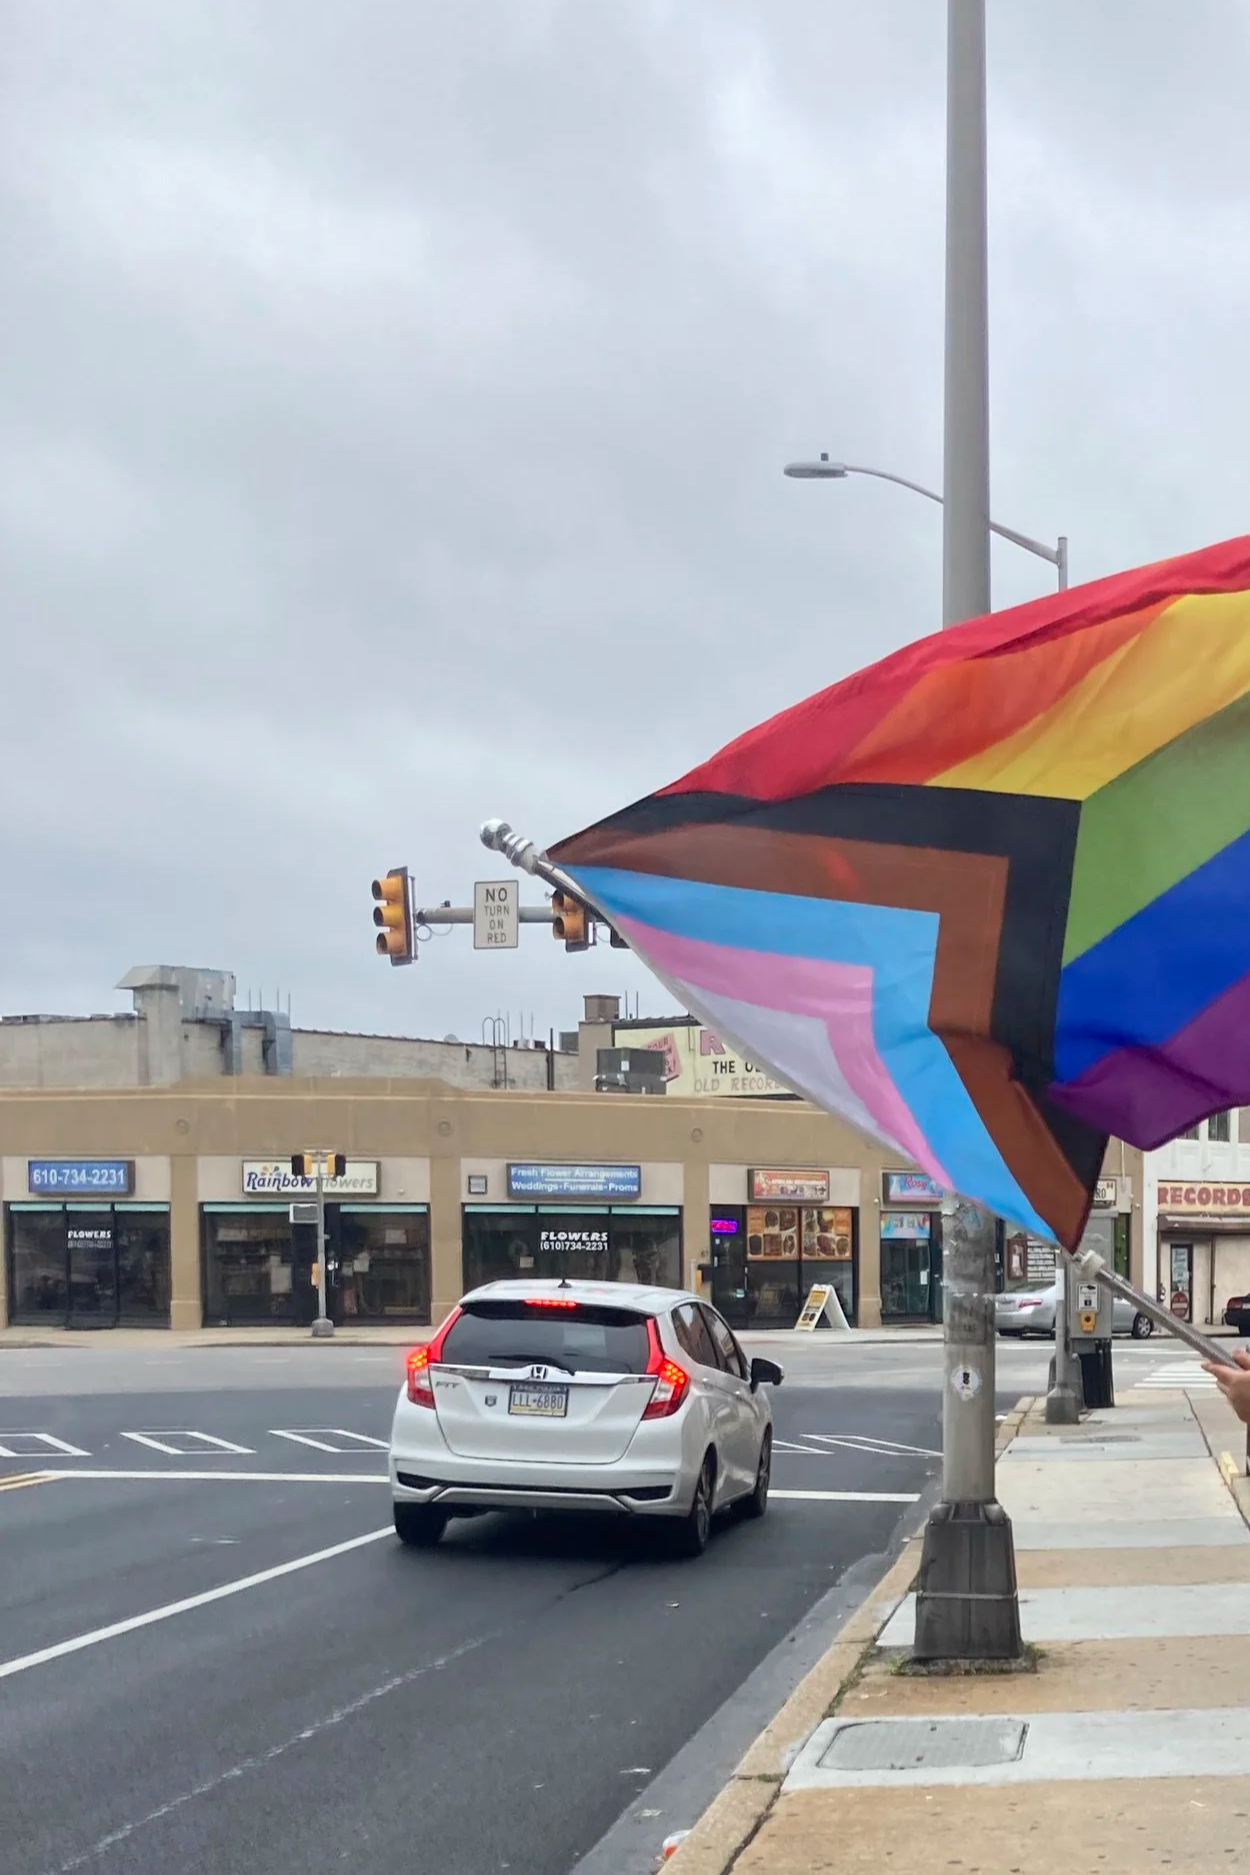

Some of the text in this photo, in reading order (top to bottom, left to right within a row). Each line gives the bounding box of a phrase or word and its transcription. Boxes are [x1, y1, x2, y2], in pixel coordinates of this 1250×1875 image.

[485, 887, 508, 902] NO
[484, 904, 510, 917] TURN
[489, 919, 504, 930] ON
[487, 932, 507, 944] RED
[712, 1060, 736, 1074] THE
[693, 1076, 721, 1093] OLD
[33, 1168, 125, 1185] 610-734-2231
[511, 1167, 538, 1177] Fresh
[541, 1168, 572, 1178] Flower
[246, 1171, 313, 1191] Rainbow
[511, 1181, 558, 1192] Weddings
[608, 1183, 638, 1192] Proms
[67, 1230, 112, 1239] FLOWERS
[540, 1231, 608, 1241] FLOWERS
[540, 1241, 608, 1251] (610)734-2231
